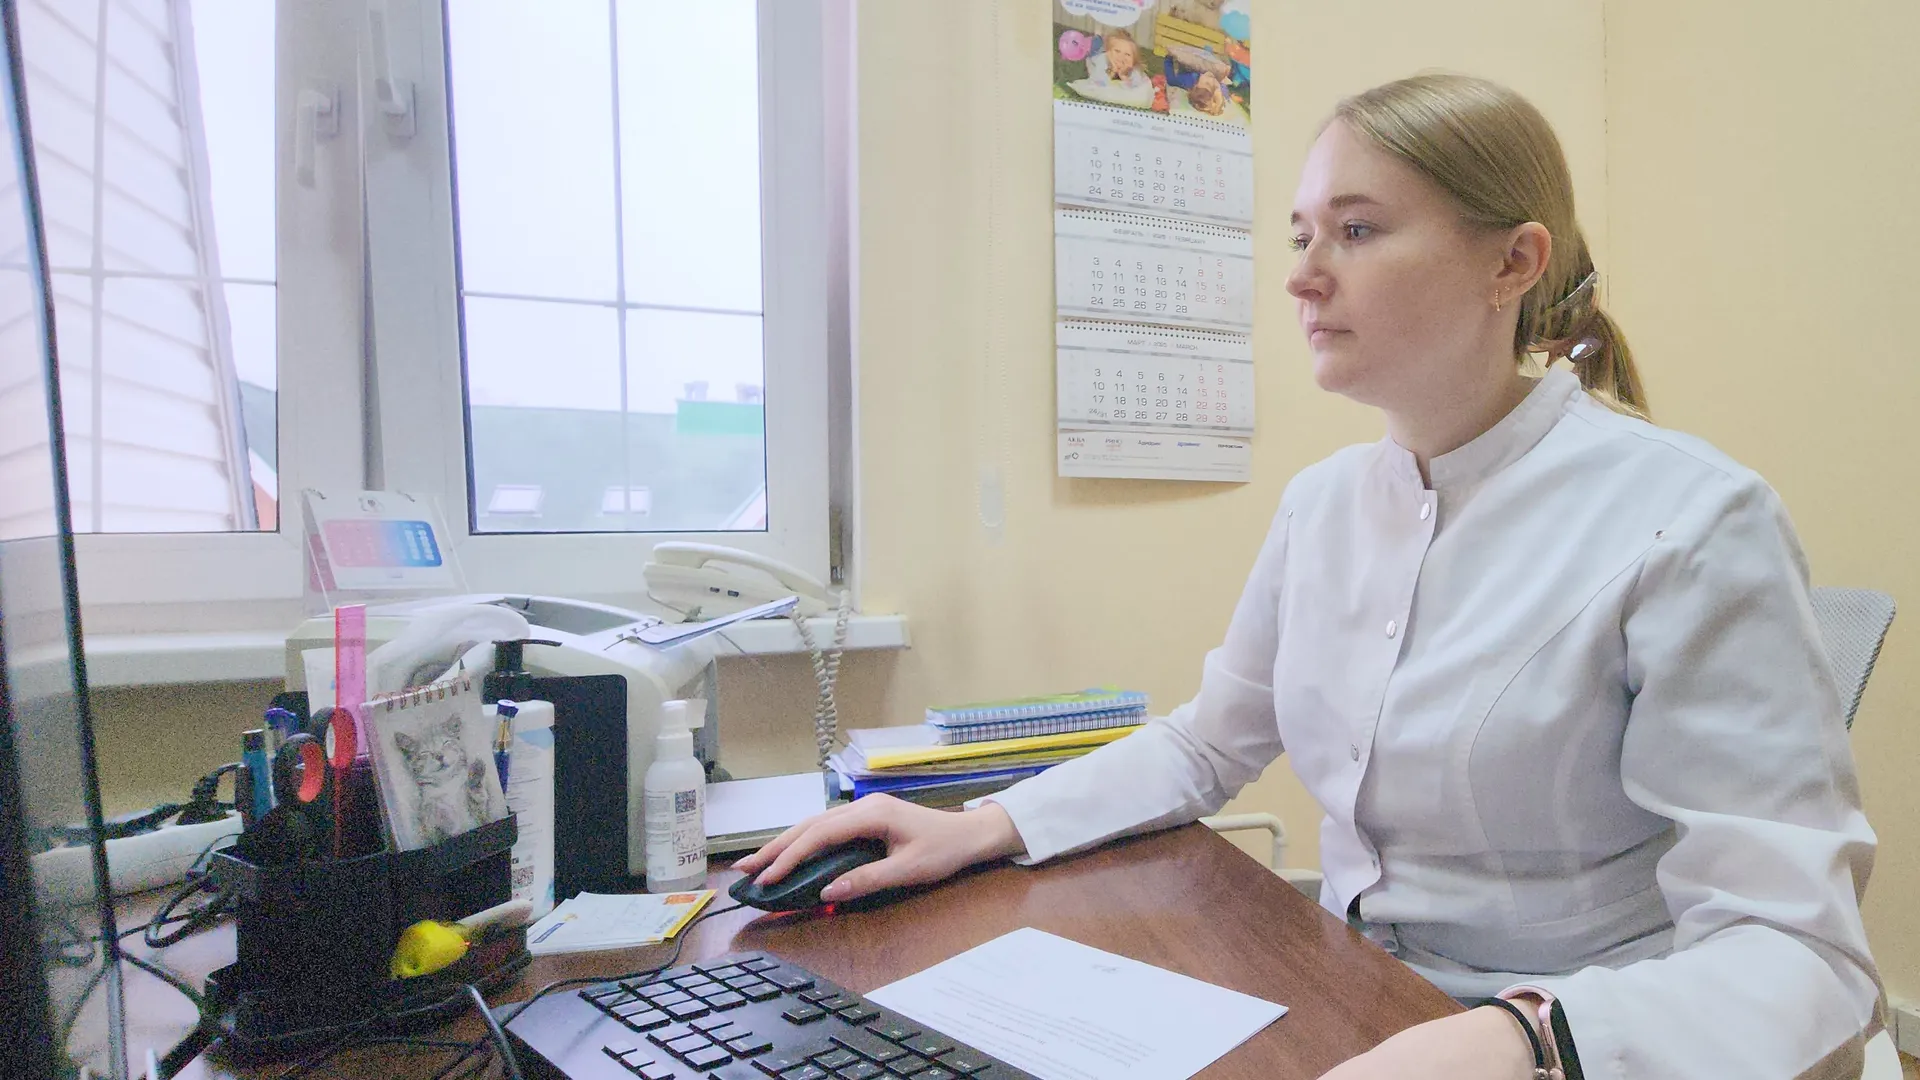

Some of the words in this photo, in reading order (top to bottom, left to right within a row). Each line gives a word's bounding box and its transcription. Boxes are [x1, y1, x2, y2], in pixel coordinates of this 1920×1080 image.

[1090, 159, 1103, 169] 10
[1111, 163, 1122, 171] 11
[1133, 166, 1144, 175] 12
[1154, 170, 1165, 178] 13
[1174, 173, 1185, 181] 14
[1194, 175, 1207, 186] 15
[1214, 179, 1225, 188] 16
[1090, 173, 1101, 182] 17
[1112, 176, 1123, 185] 18
[1133, 180, 1146, 188] 19
[1153, 182, 1166, 192] 20
[1173, 185, 1185, 194] 21
[1193, 188, 1205, 197] 22
[1213, 191, 1225, 200] 23
[1089, 186, 1101, 195] 24
[1110, 189, 1124, 198] 25
[1132, 192, 1144, 201] 26
[1152, 195, 1165, 204] 27
[1173, 198, 1185, 207] 28
[1092, 271, 1104, 279] 10
[1113, 272, 1124, 282] 11
[1135, 275, 1146, 283] 12
[1156, 277, 1167, 286] 13
[1176, 280, 1187, 288] 14
[1195, 281, 1208, 291] 15
[1216, 284, 1227, 292] 16
[1092, 284, 1103, 292] 17
[1114, 286, 1125, 294] 18
[1134, 288, 1147, 297] 19
[1154, 290, 1168, 299] 20
[1174, 292, 1186, 301] 21
[1195, 294, 1207, 303] 22
[1215, 296, 1226, 305] 23
[1091, 297, 1103, 305] 24
[1113, 298, 1126, 307] 25
[1134, 300, 1147, 309] 26
[1154, 302, 1167, 311] 27
[1176, 305, 1187, 313] 28
[1176, 343, 1198, 351] MARCH
[1093, 382, 1105, 390] 10
[1114, 383, 1125, 391] 11
[1136, 385, 1147, 393] 12
[1156, 385, 1169, 395] 13
[1176, 388, 1187, 396] 14
[1196, 388, 1208, 397] 15
[1216, 390, 1227, 399] 16
[1093, 395, 1104, 403] 17
[1115, 397, 1126, 405] 18
[1135, 398, 1148, 407] 19
[1156, 398, 1169, 408] 20
[1175, 400, 1186, 410] 21
[1196, 401, 1209, 410] 22
[1215, 402, 1227, 410] 23
[1114, 409, 1127, 418] 25
[1135, 410, 1148, 419] 26
[1155, 411, 1169, 420] 27
[1176, 413, 1188, 421] 28
[1195, 414, 1208, 422] 29
[1215, 415, 1227, 423] 30
